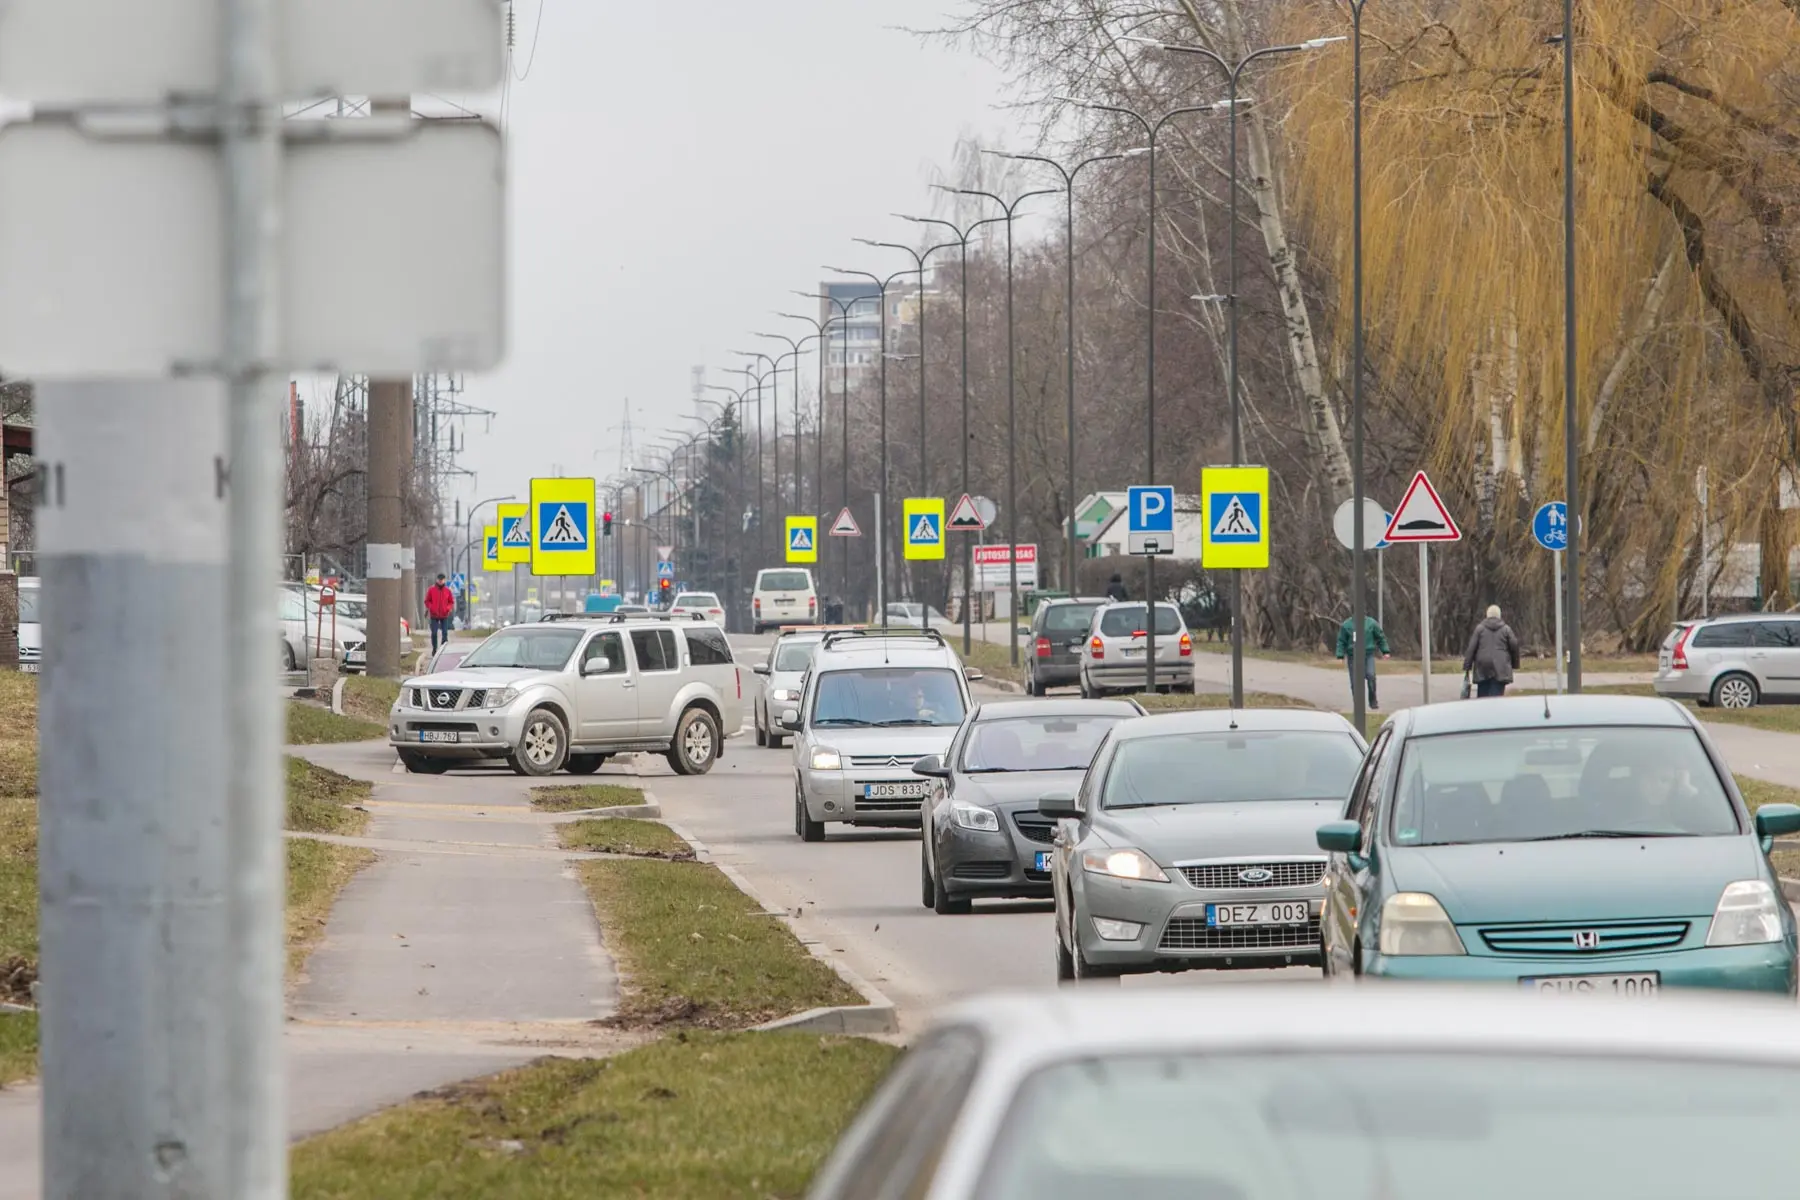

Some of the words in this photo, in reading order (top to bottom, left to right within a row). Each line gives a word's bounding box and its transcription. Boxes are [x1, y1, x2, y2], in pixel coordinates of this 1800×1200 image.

[1141, 491, 1165, 527] P
[425, 732, 440, 740] HBJ
[443, 733, 456, 741] 762
[872, 785, 895, 796] JDS
[902, 785, 922, 795] 833
[1218, 906, 1258, 923] DEZ
[1271, 904, 1306, 921] 003
